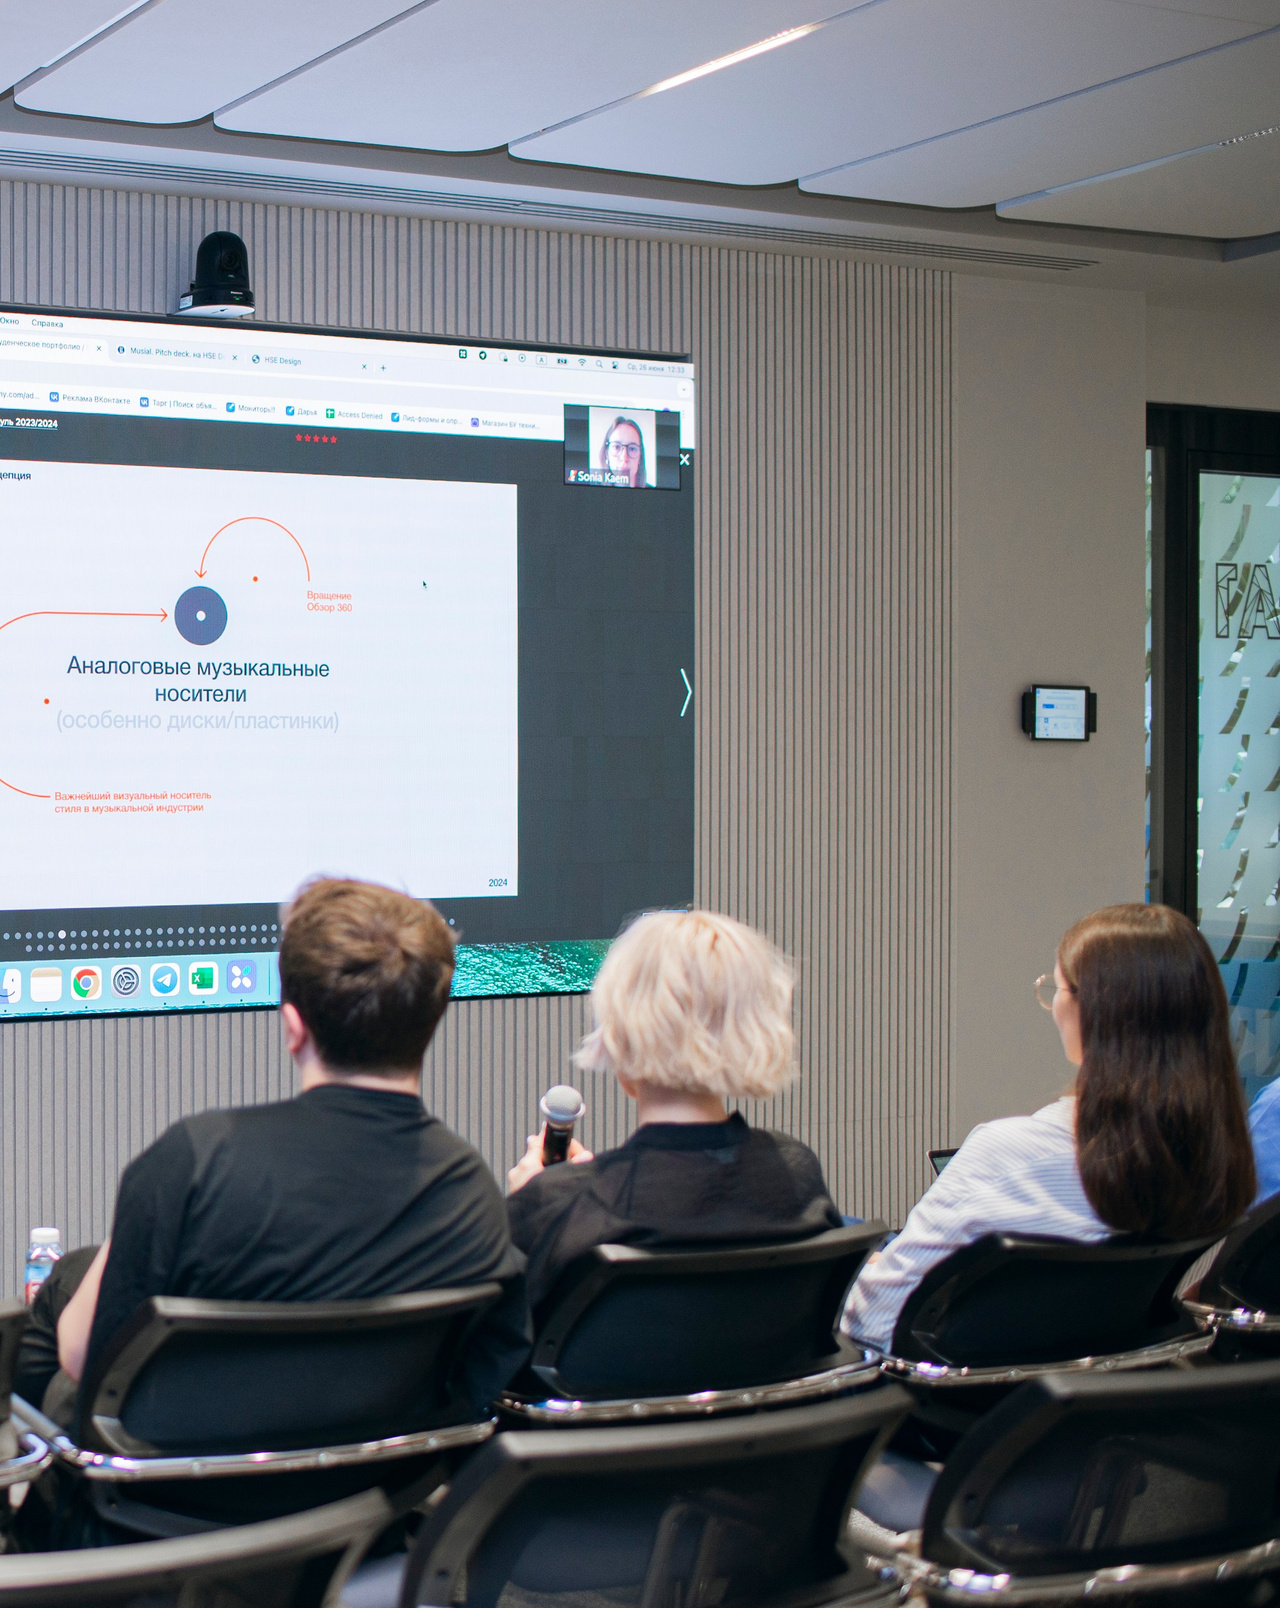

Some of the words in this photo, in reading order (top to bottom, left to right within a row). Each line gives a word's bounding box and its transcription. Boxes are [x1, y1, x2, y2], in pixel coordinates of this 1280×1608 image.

[0, 316, 20, 325] Окно
[32, 319, 64, 328] Справка
[42, 341, 80, 351] портфолио
[279, 357, 301, 366] Design
[62, 394, 92, 402] Реклама
[94, 396, 130, 404] ВКонтакте
[173, 400, 194, 409] Поиск
[297, 408, 317, 416] Дарья
[361, 412, 383, 420] Denied
[16, 418, 58, 428] 2023/2024
[578, 470, 603, 482] Sonia
[605, 472, 629, 484] Kaem
[307, 591, 352, 601] Вращение
[307, 602, 335, 613] Обзор
[337, 603, 352, 612] 360
[66, 656, 191, 675] Аналоговые
[197, 661, 330, 679] музыкальные
[155, 687, 247, 702] носители
[56, 710, 161, 732] (особенно
[167, 711, 340, 733] диски/пластинки)
[55, 791, 111, 801] Важнейший
[113, 791, 168, 802] визуальный
[55, 805, 81, 813] стиля
[92, 804, 154, 814] музыкальной
[156, 804, 204, 813] индустрии
[489, 878, 508, 887] 2024
